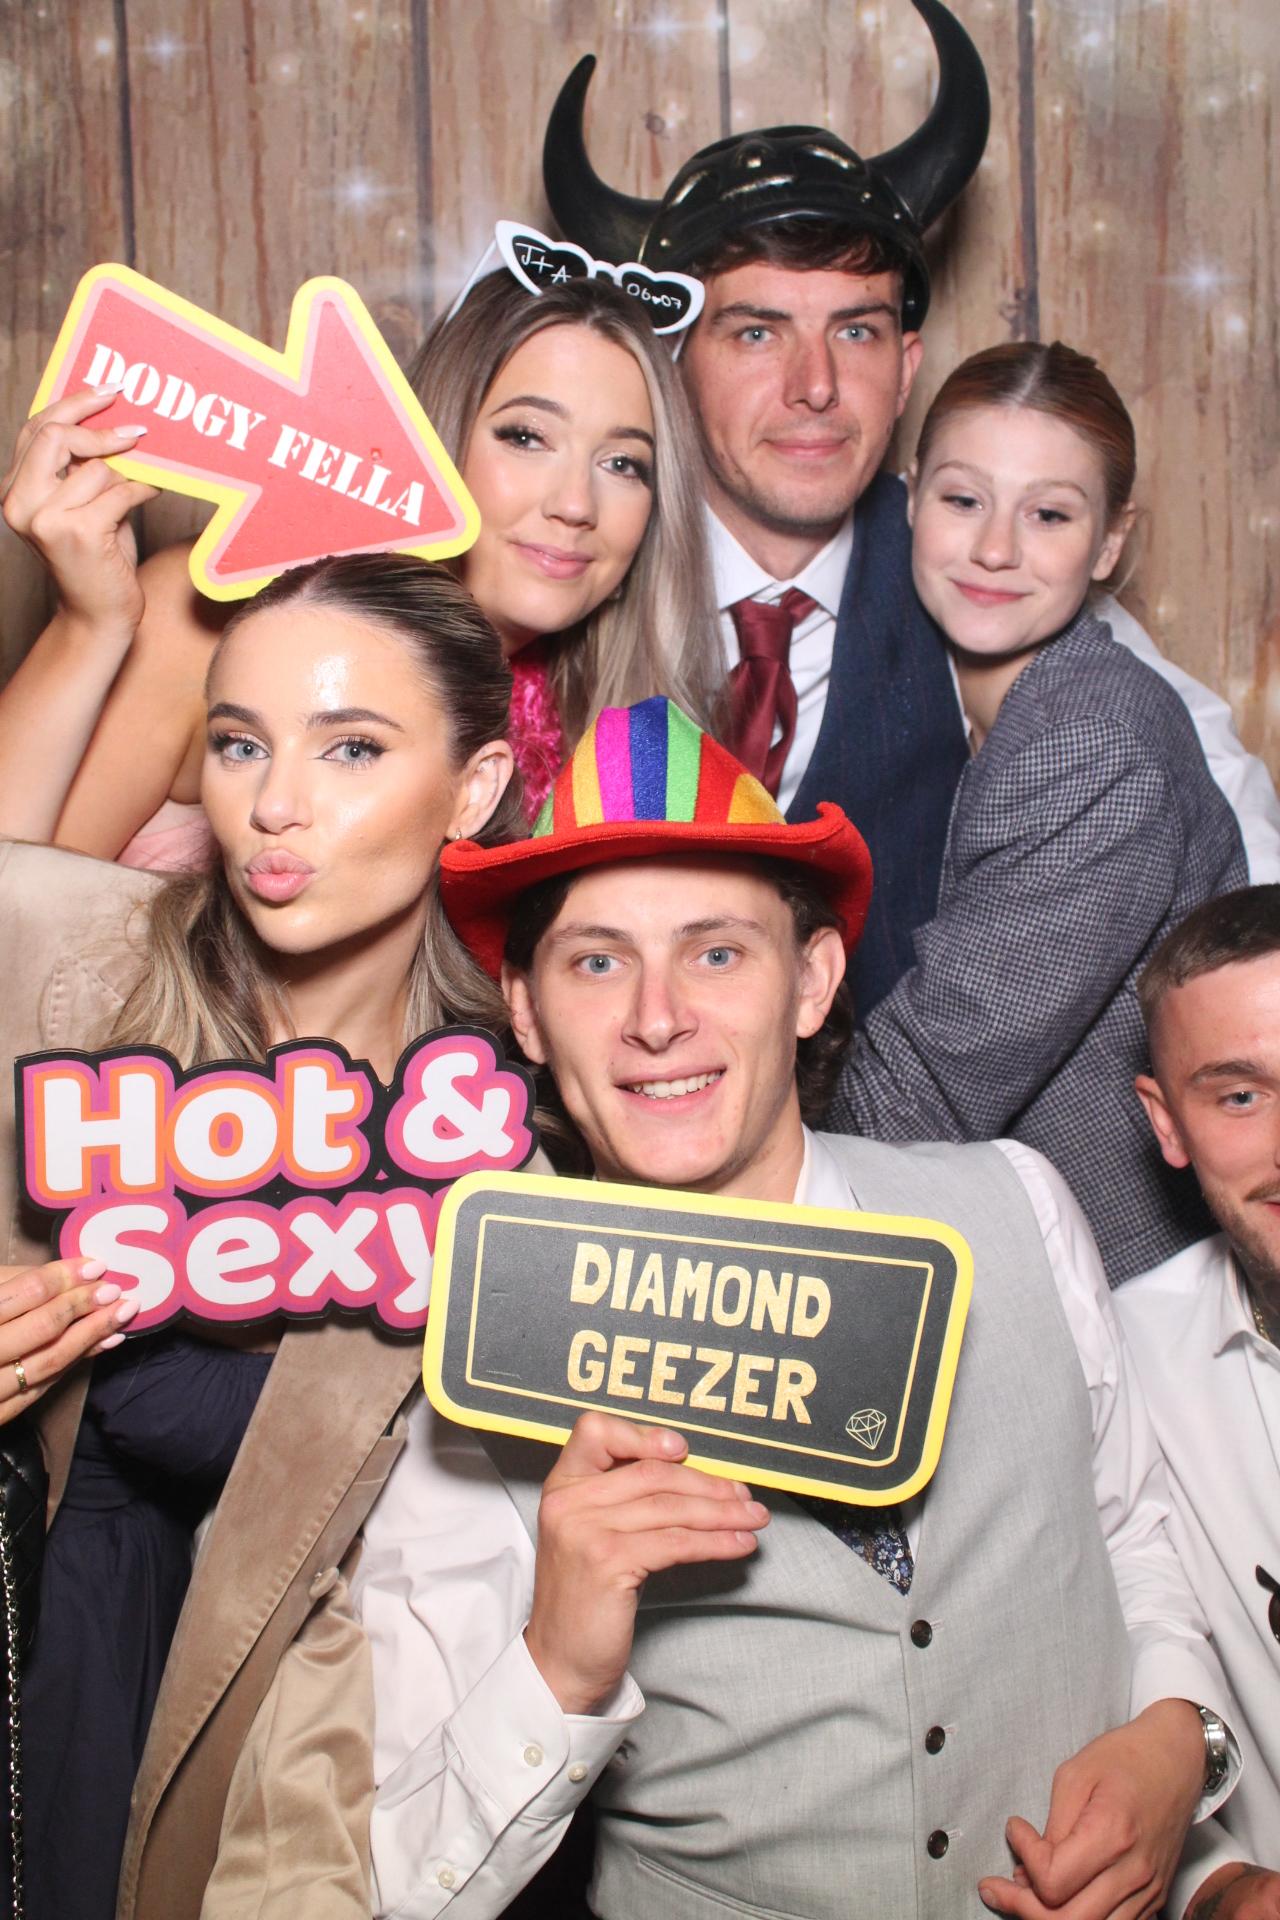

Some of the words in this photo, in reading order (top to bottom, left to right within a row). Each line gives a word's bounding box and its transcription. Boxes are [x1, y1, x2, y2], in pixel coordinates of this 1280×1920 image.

[83, 344, 266, 451] DODGY
[267, 424, 426, 526] FELLA
[44, 1065, 355, 1192] Hot
[403, 1052, 514, 1163] &
[570, 1242, 831, 1337] DIAMOND
[567, 1329, 817, 1424] GEEZER
